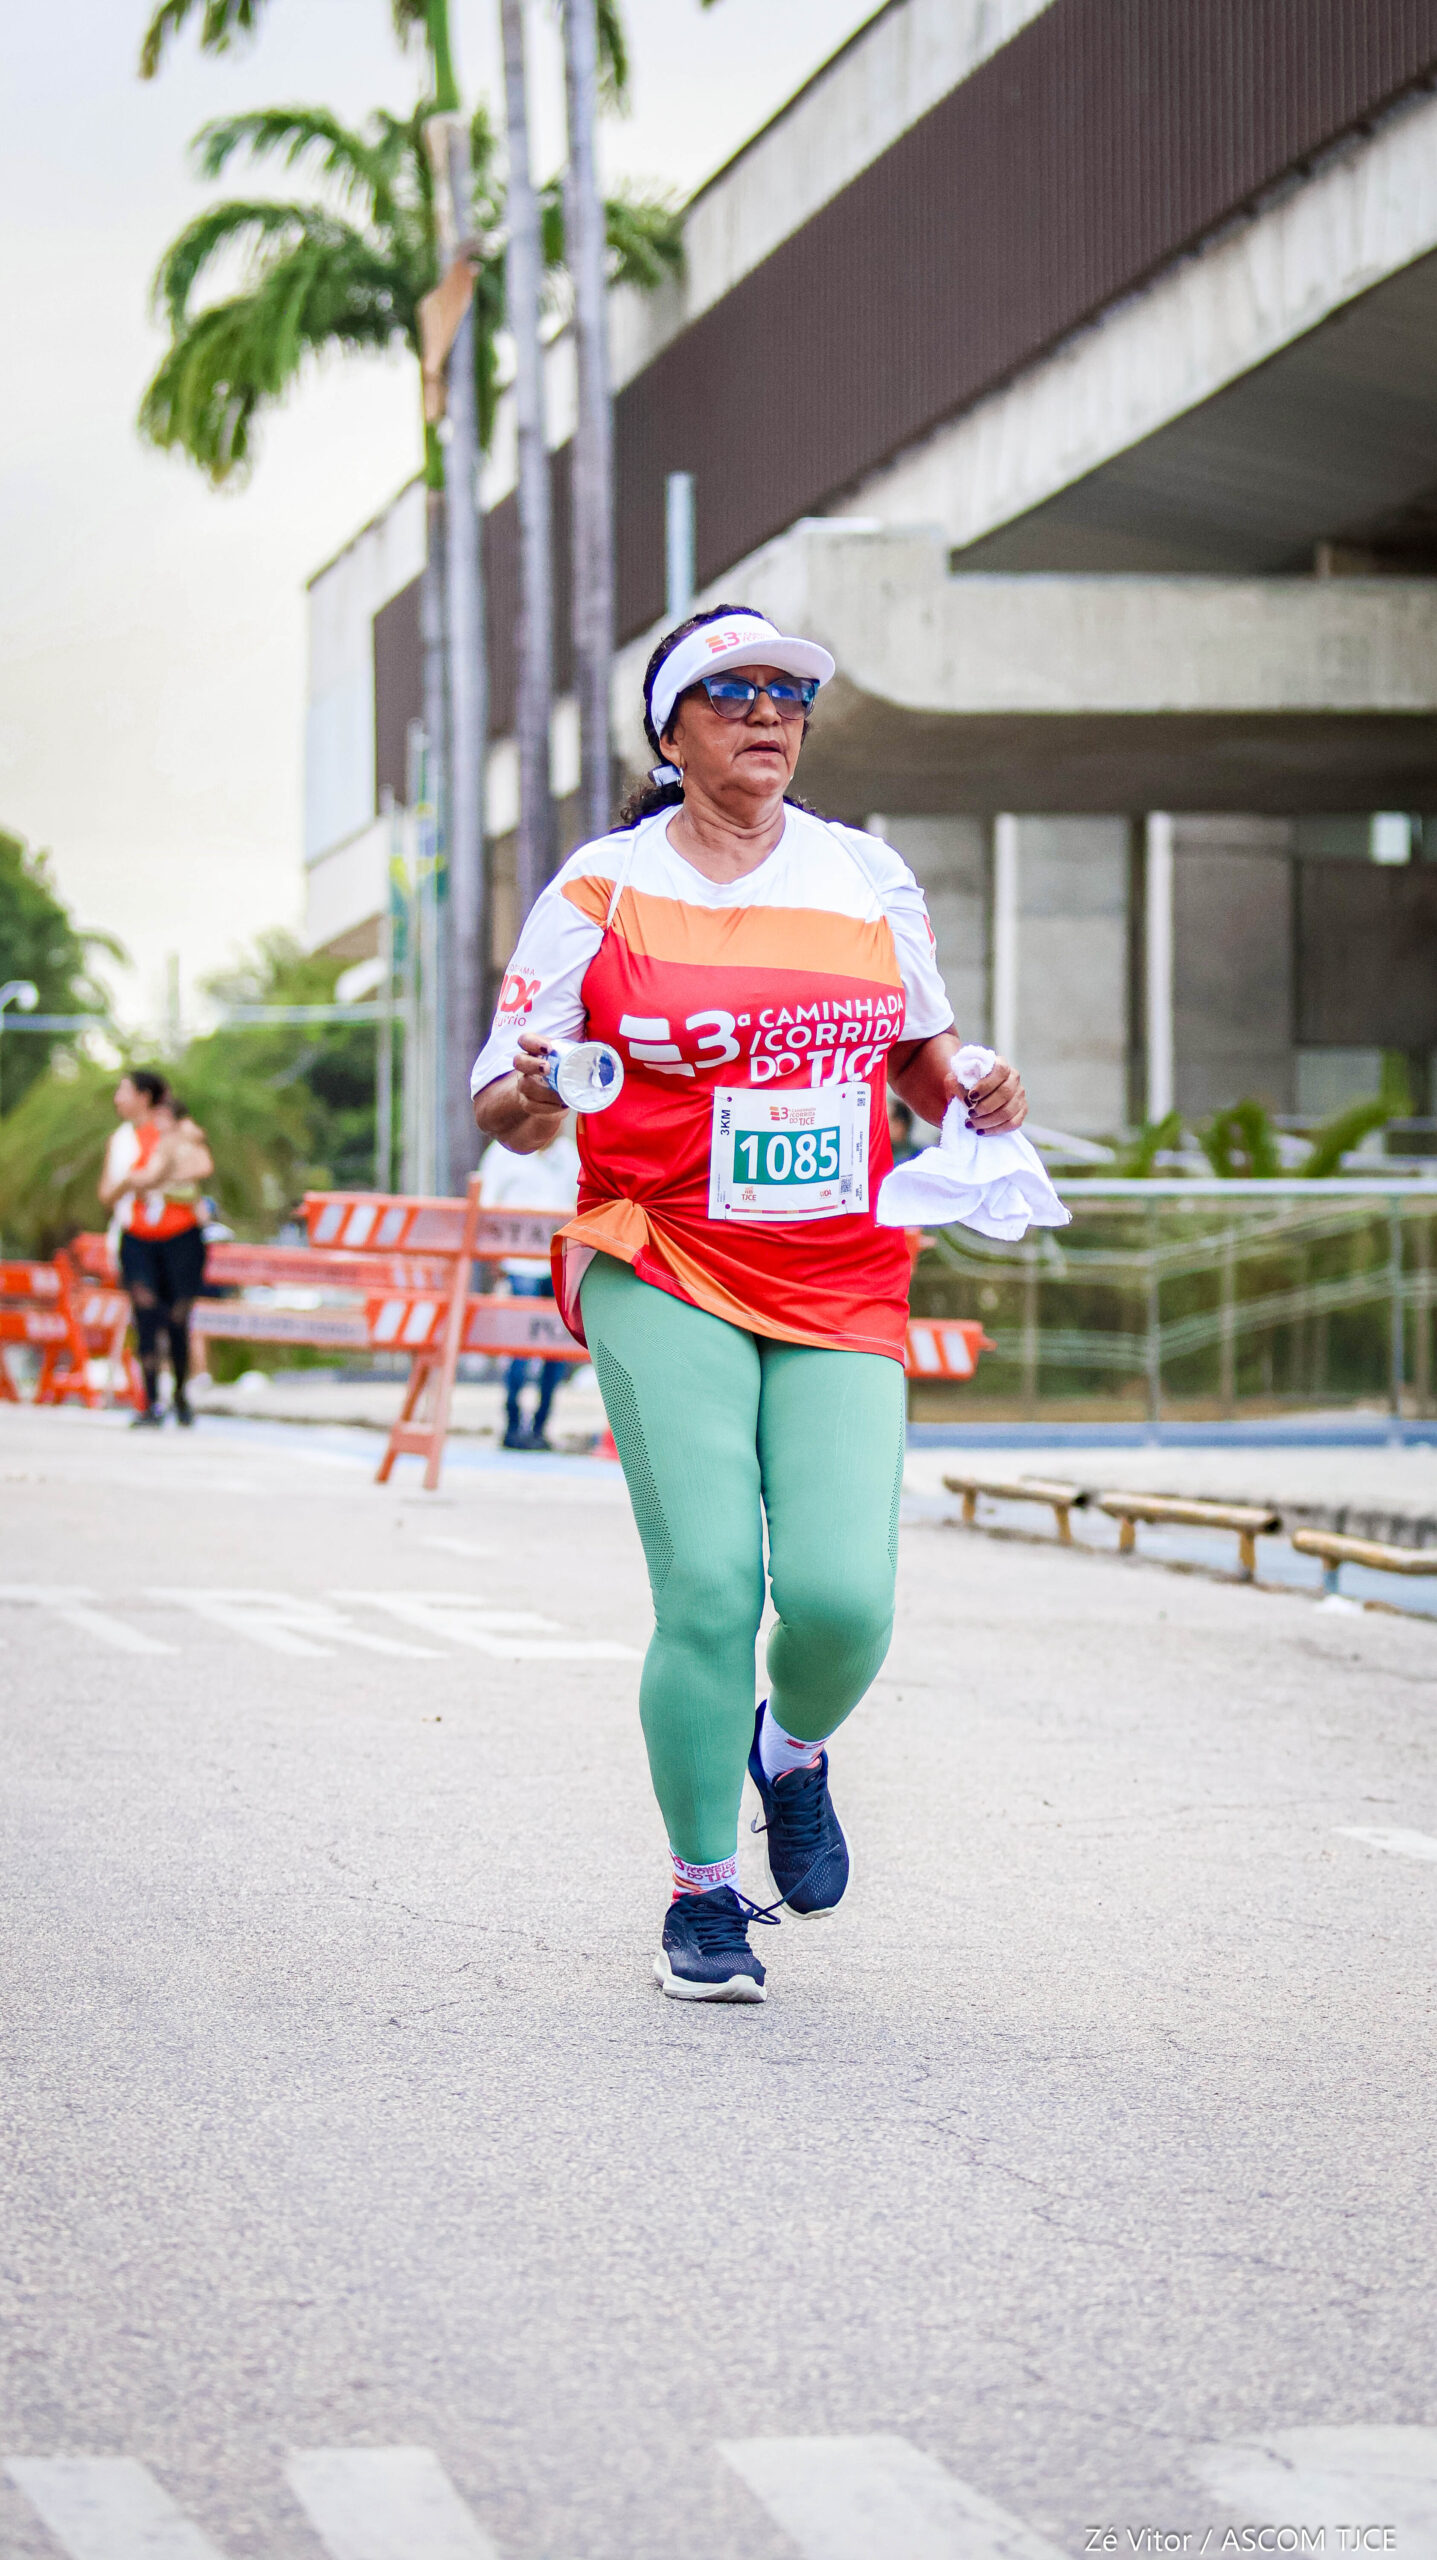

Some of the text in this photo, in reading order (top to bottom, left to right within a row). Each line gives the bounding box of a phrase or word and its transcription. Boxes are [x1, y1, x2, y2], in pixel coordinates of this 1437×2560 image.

[759, 993, 904, 1028] CAMINHADA
[749, 1015, 901, 1055] /CORRIDA
[750, 1052, 801, 1083] DO
[720, 1109, 731, 1136] 3KM
[799, 1117, 816, 1126] TJCE
[739, 1130, 838, 1181] 1085
